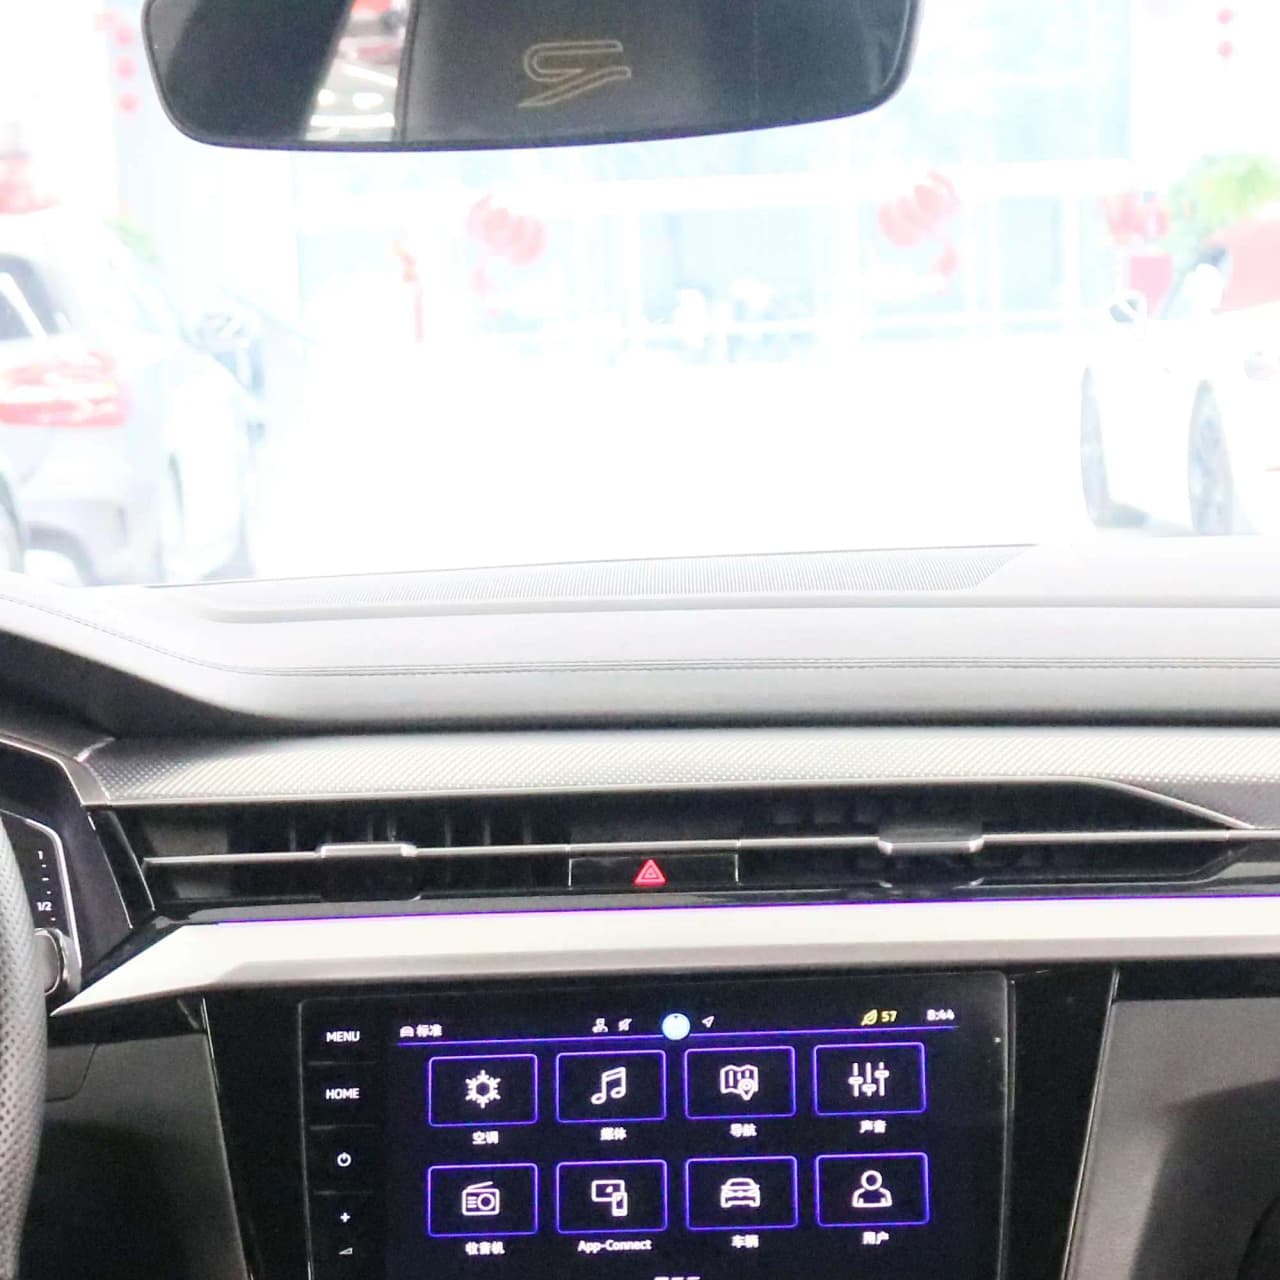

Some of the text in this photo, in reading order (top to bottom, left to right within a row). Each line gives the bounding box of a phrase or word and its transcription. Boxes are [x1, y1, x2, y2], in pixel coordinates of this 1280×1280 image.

[37, 901, 53, 912] 1/2
[881, 1010, 898, 1023] 57
[926, 1008, 956, 1022] 8:44
[326, 1030, 361, 1043] MENU
[325, 1087, 361, 1100] HOME
[599, 1126, 628, 1141] 媒体
[729, 1122, 758, 1138] 导航
[858, 1119, 888, 1134] 声音
[472, 1130, 500, 1145] 空调
[730, 1234, 760, 1249] 车辆
[861, 1231, 890, 1246] 用户
[465, 1241, 506, 1256] 收音机
[577, 1239, 653, 1254] App-Connect
